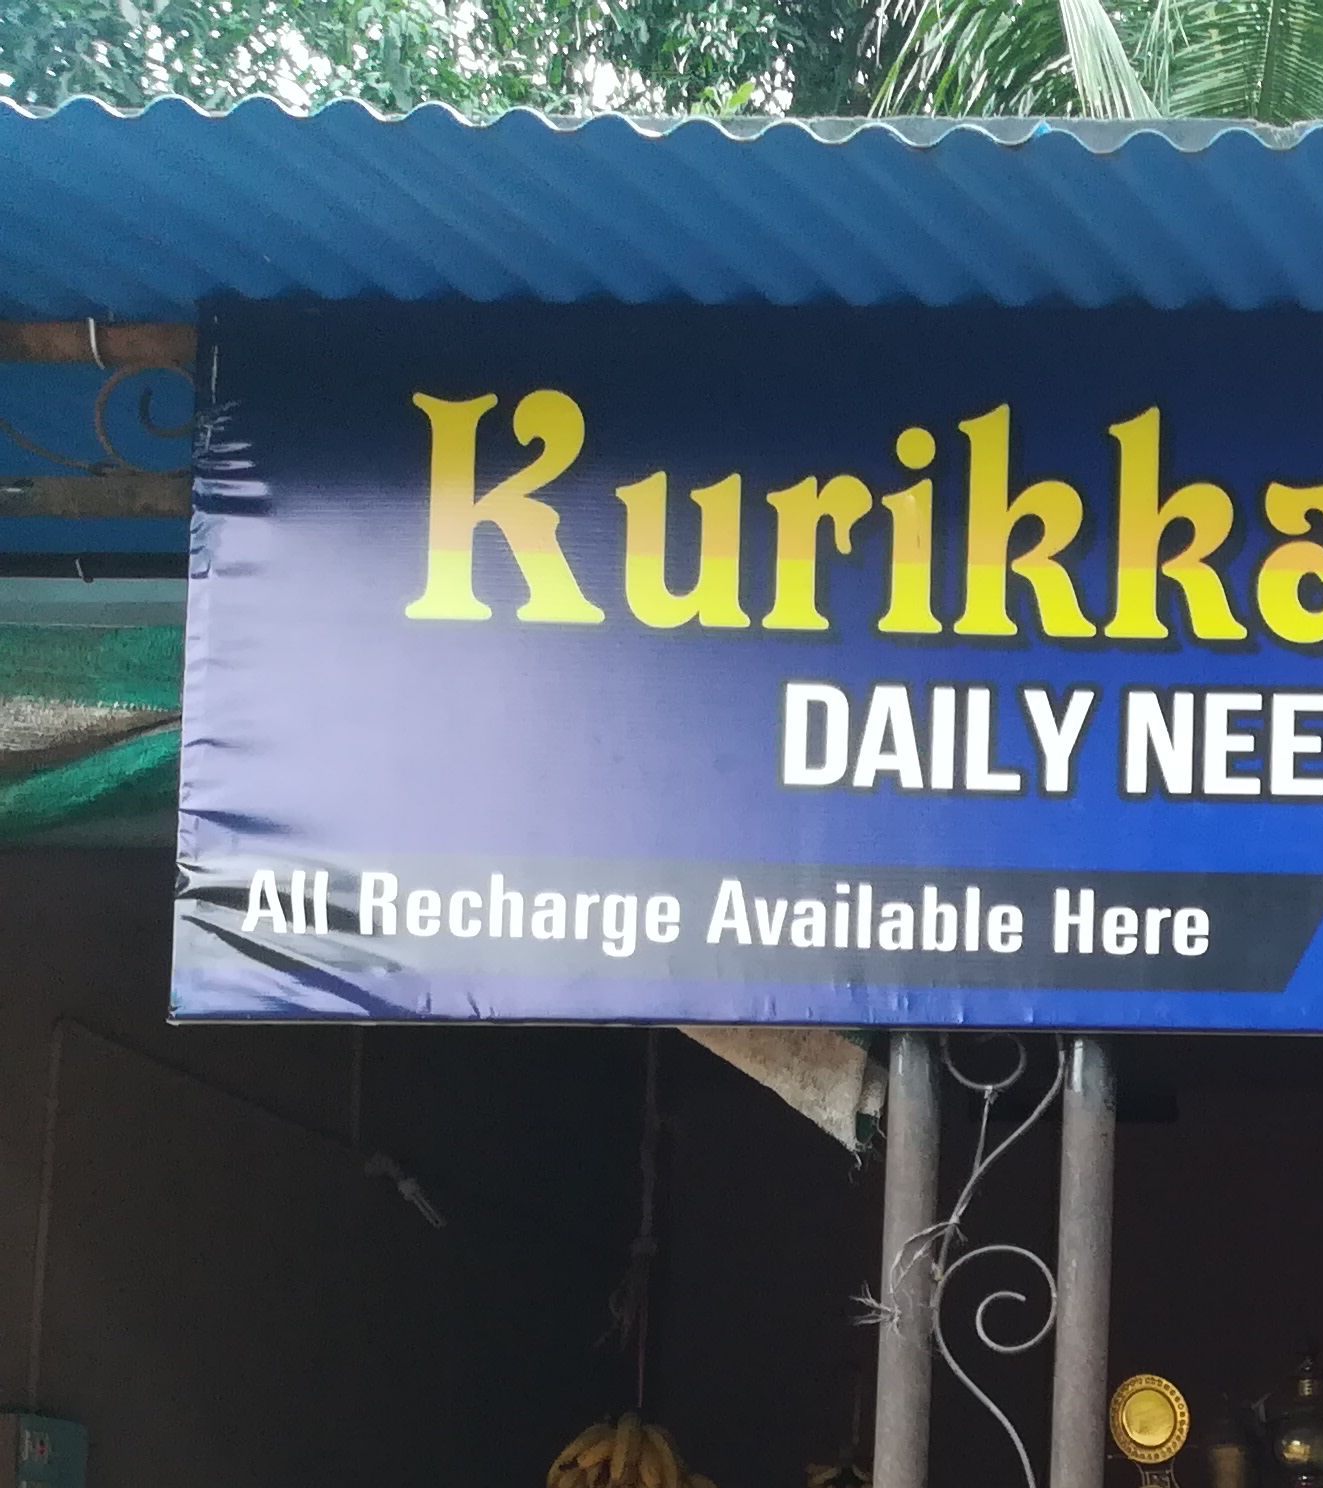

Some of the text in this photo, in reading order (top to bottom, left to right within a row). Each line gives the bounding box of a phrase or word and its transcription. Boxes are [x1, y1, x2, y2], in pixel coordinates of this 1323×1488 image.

[781, 682, 1096, 793] DAILY
[241, 868, 1212, 957] All Recharge Available Here
